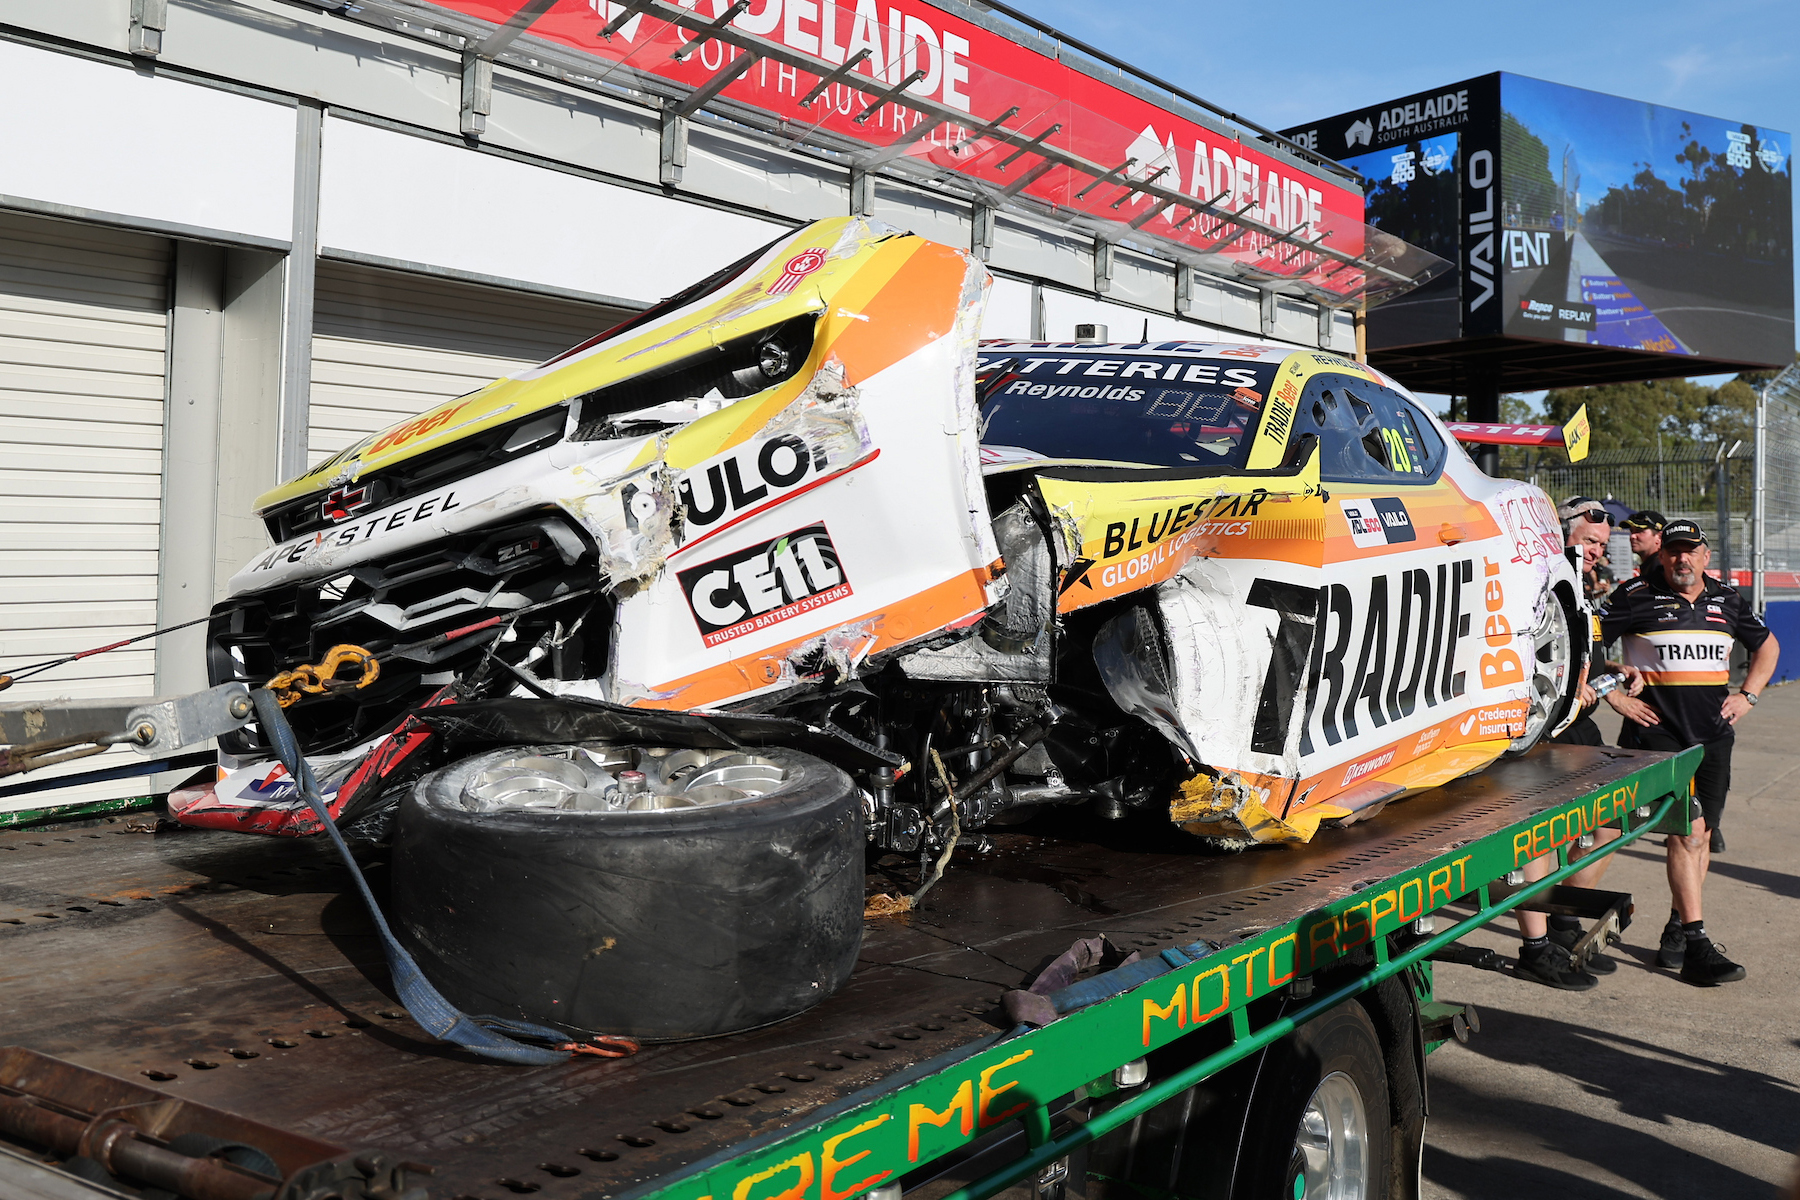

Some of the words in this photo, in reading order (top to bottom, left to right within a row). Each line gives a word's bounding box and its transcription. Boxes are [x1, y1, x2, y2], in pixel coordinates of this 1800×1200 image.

[1377, 129, 1410, 144] SOUTH
[1413, 113, 1470, 135] AUSTRALIA
[1378, 90, 1469, 132] ADELAIDE
[1189, 139, 1323, 246] ADELAIDE
[1469, 149, 1494, 313] VAILO
[1558, 309, 1592, 322] REPLAY
[1004, 380, 1146, 402] Reynolds
[1277, 380, 1299, 407] Beer
[368, 400, 474, 455] Beer
[1263, 397, 1293, 446] TRADIE
[1382, 427, 1412, 473] 20
[335, 491, 461, 548] STEEL
[1103, 488, 1270, 560] BLUESTAR
[1380, 510, 1408, 528] VAILO
[1101, 547, 1165, 588] GLOBAL
[1168, 521, 1253, 558] LOGISTICS
[706, 617, 754, 646] TRUSTED
[755, 604, 801, 629] BATTERY
[801, 585, 849, 611] SYSTEMS
[1245, 558, 1473, 758] TRADIE
[1479, 556, 1525, 690] Beer
[1654, 644, 1725, 660] TRADIE
[1478, 707, 1523, 721] Credence
[1479, 722, 1523, 735] Insurance
[1351, 750, 1396, 779] KENWORTH
[1513, 781, 1639, 868] RECOVERY
[1142, 854, 1473, 1047] MOTORSPORT
